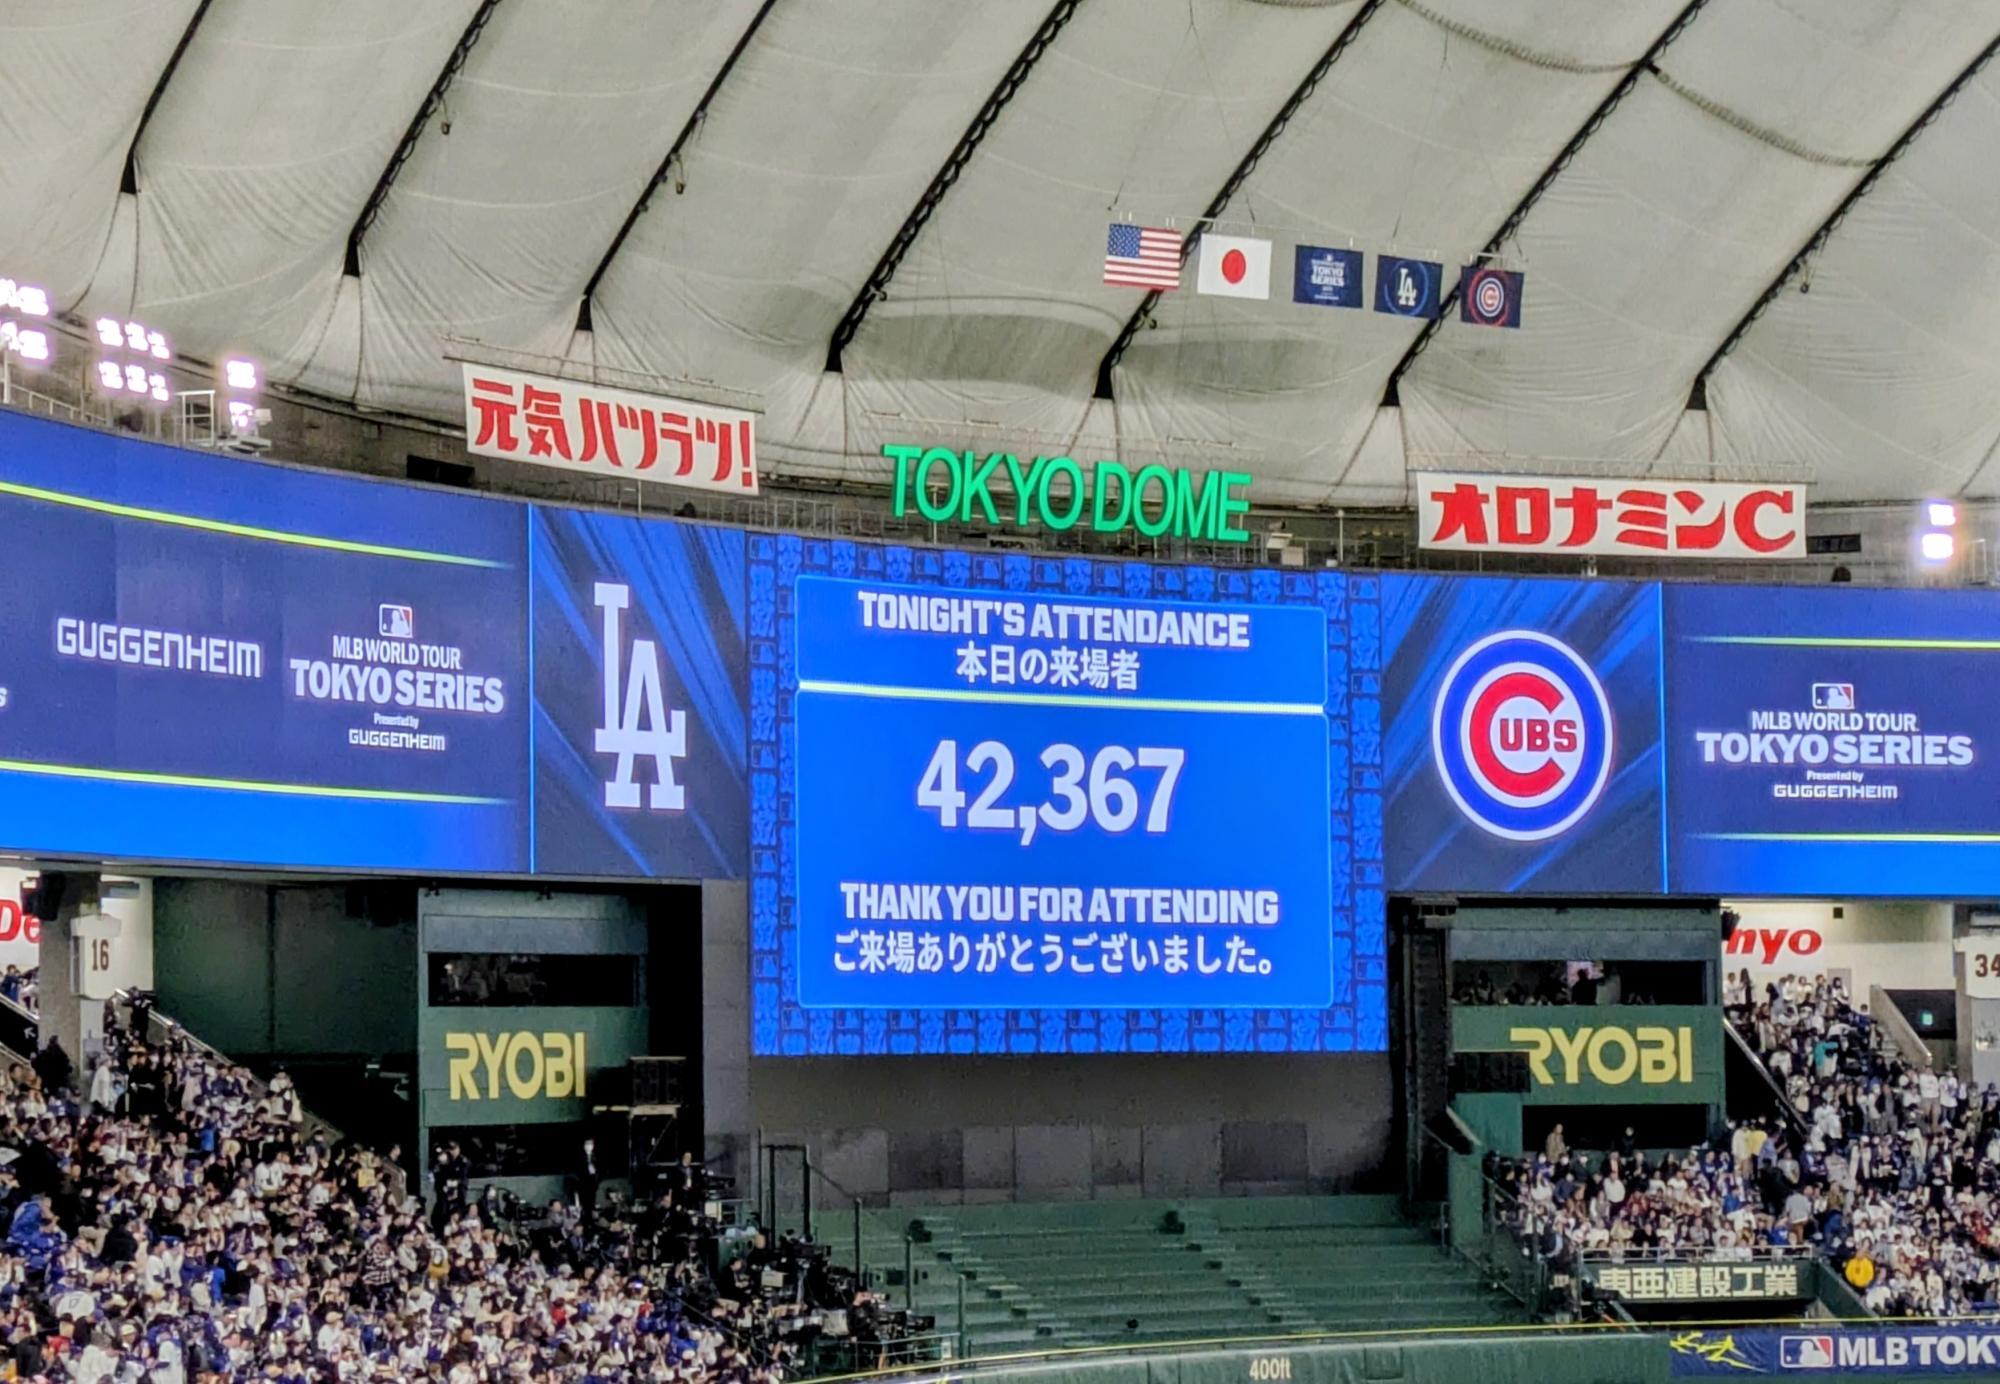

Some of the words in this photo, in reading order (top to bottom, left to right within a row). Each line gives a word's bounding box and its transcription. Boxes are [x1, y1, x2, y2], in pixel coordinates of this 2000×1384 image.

[1398, 268, 1417, 306] LA
[882, 443, 1085, 531] TOKYO
[1091, 460, 1253, 541] DOME
[1430, 482, 1796, 553] オロナミンC
[858, 591, 1025, 636] TONIGHT'S
[1030, 603, 1251, 648] ATTENDANCE
[56, 617, 262, 678] GUGGENHEIM
[332, 635, 363, 660] MLB
[364, 638, 420, 665] WORLD
[420, 643, 461, 669] TOUR
[956, 641, 1141, 690] 本日の来場者
[290, 658, 392, 704] TOKYO
[394, 669, 504, 713] SERIES
[593, 582, 687, 810] LA
[348, 728, 446, 751] GUGGENHEIM
[373, 712, 409, 727] Presented
[1752, 711, 1791, 730] MLB
[1794, 712, 1863, 731] WORLD
[1865, 713, 1917, 732] TOUR
[1696, 732, 1829, 763] TOKYO
[1833, 735, 1974, 765] SERIES
[917, 739, 1185, 846] 42,367
[1773, 784, 1898, 799] GUGGENHEIM
[1806, 770, 1852, 781] Presented
[1852, 771, 1864, 783] by
[841, 882, 942, 922] THANK
[946, 884, 1014, 922] YOU
[1021, 887, 1084, 923] FOR
[1088, 888, 1279, 925] ATTENDING
[92, 938, 109, 971] 16
[834, 928, 1272, 976] ご来場ありがとうございました。
[445, 1031, 586, 1100] RYOBI
[1510, 1027, 1693, 1085] RYOBI
[1599, 1264, 1798, 1299] 東亜建設工業
[1249, 1357, 1292, 1381] 400ft
[1839, 1336, 1908, 1366] MLB
